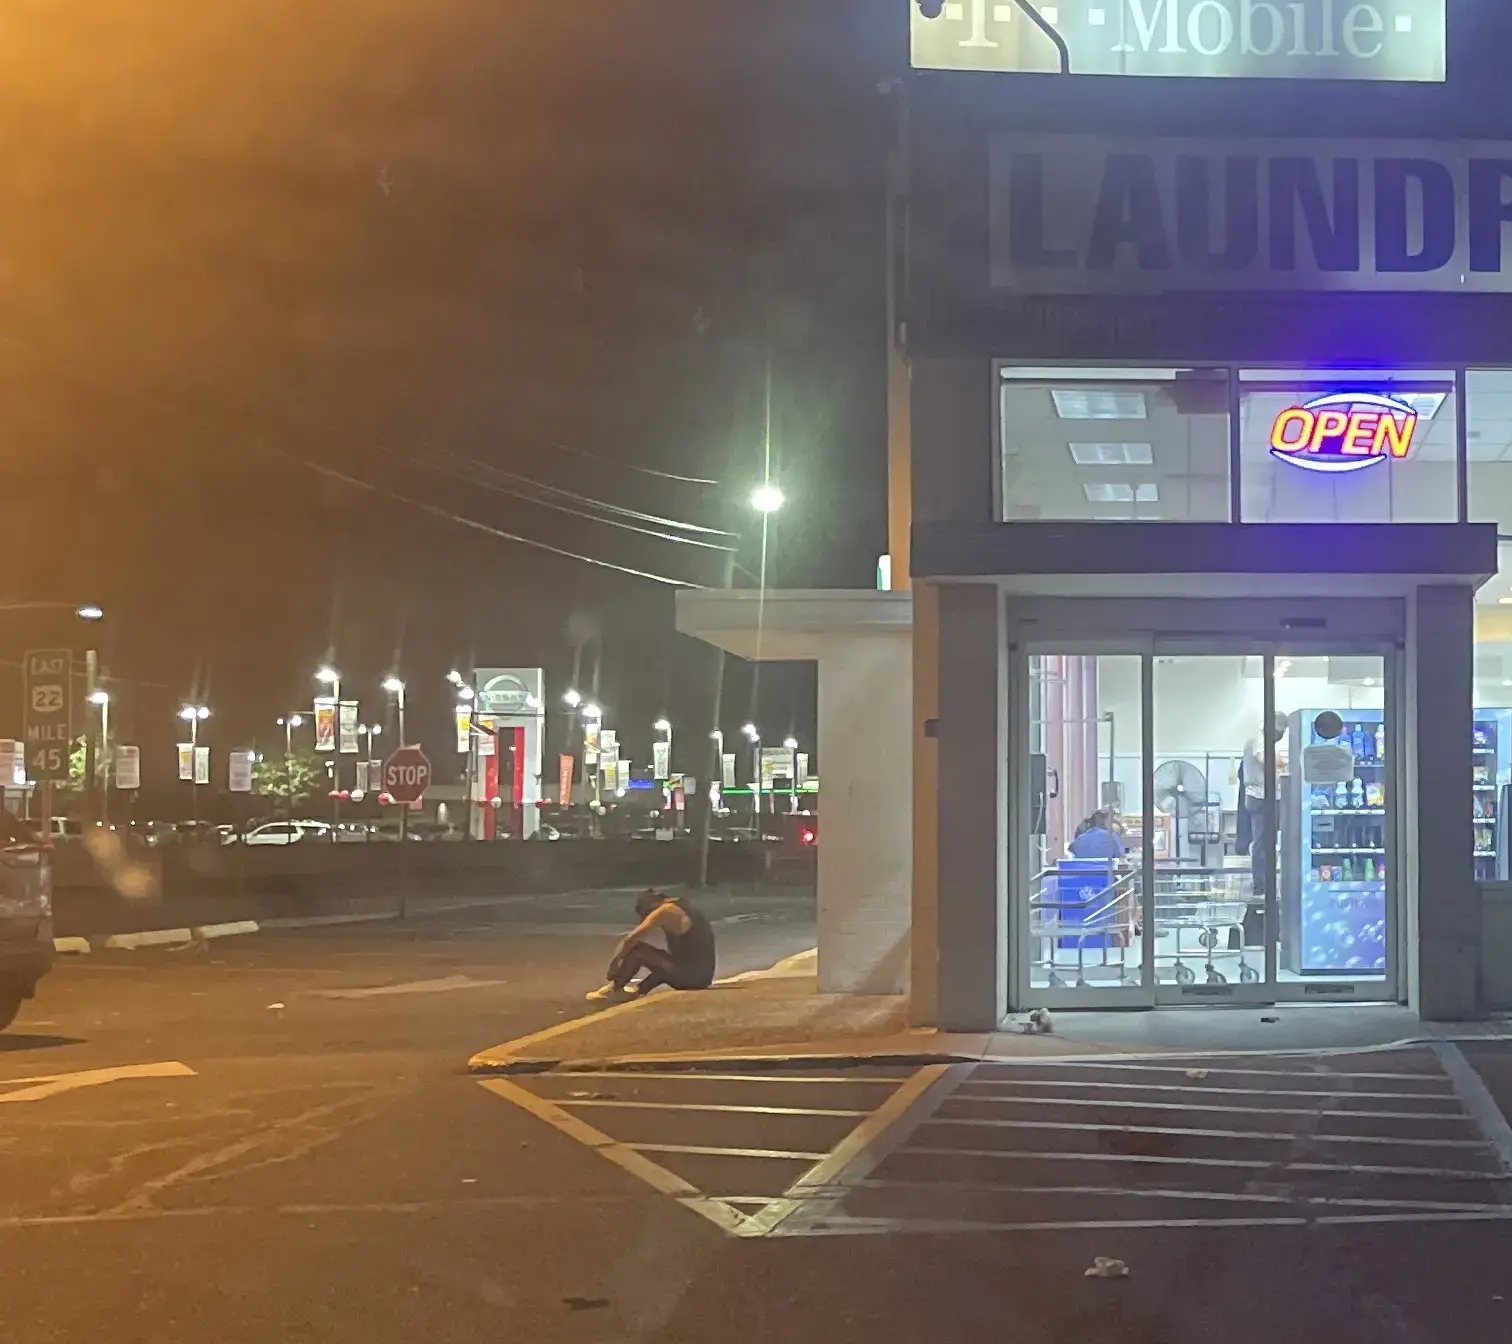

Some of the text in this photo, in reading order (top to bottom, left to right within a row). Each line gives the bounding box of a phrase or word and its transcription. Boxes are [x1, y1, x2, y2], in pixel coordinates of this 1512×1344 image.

[1270, 404, 1418, 460] OPEN
[31, 657, 65, 675] EAST
[35, 690, 61, 708] 22
[28, 724, 67, 741] MILE
[32, 748, 62, 771] 45
[387, 765, 429, 786] STOP
